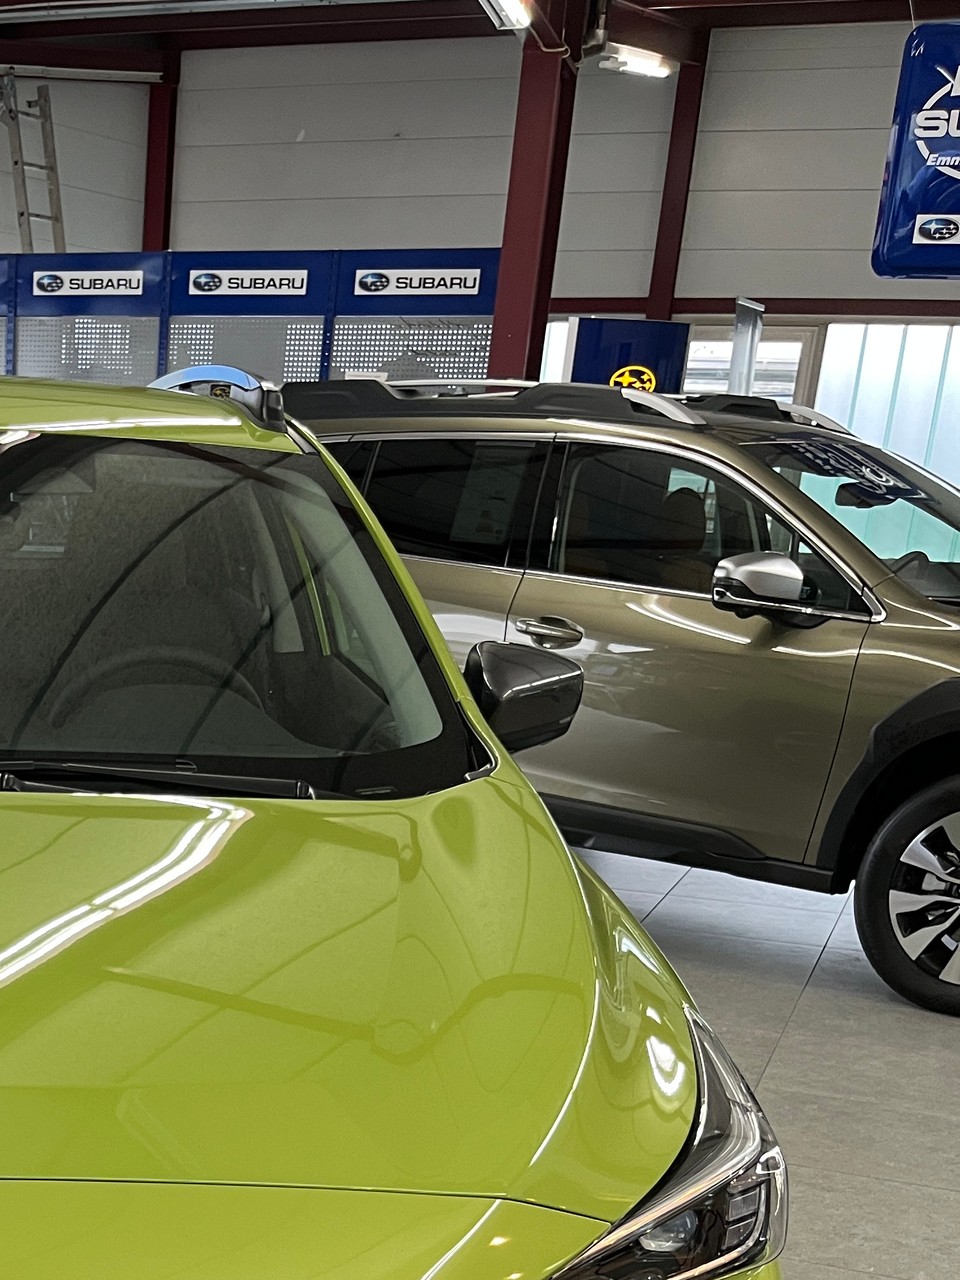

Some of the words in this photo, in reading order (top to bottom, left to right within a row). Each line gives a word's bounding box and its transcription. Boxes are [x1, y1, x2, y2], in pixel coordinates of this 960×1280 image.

[69, 278, 140, 290] SUBARU
[227, 277, 305, 290] SUBARU
[395, 276, 478, 289] SUBARU
